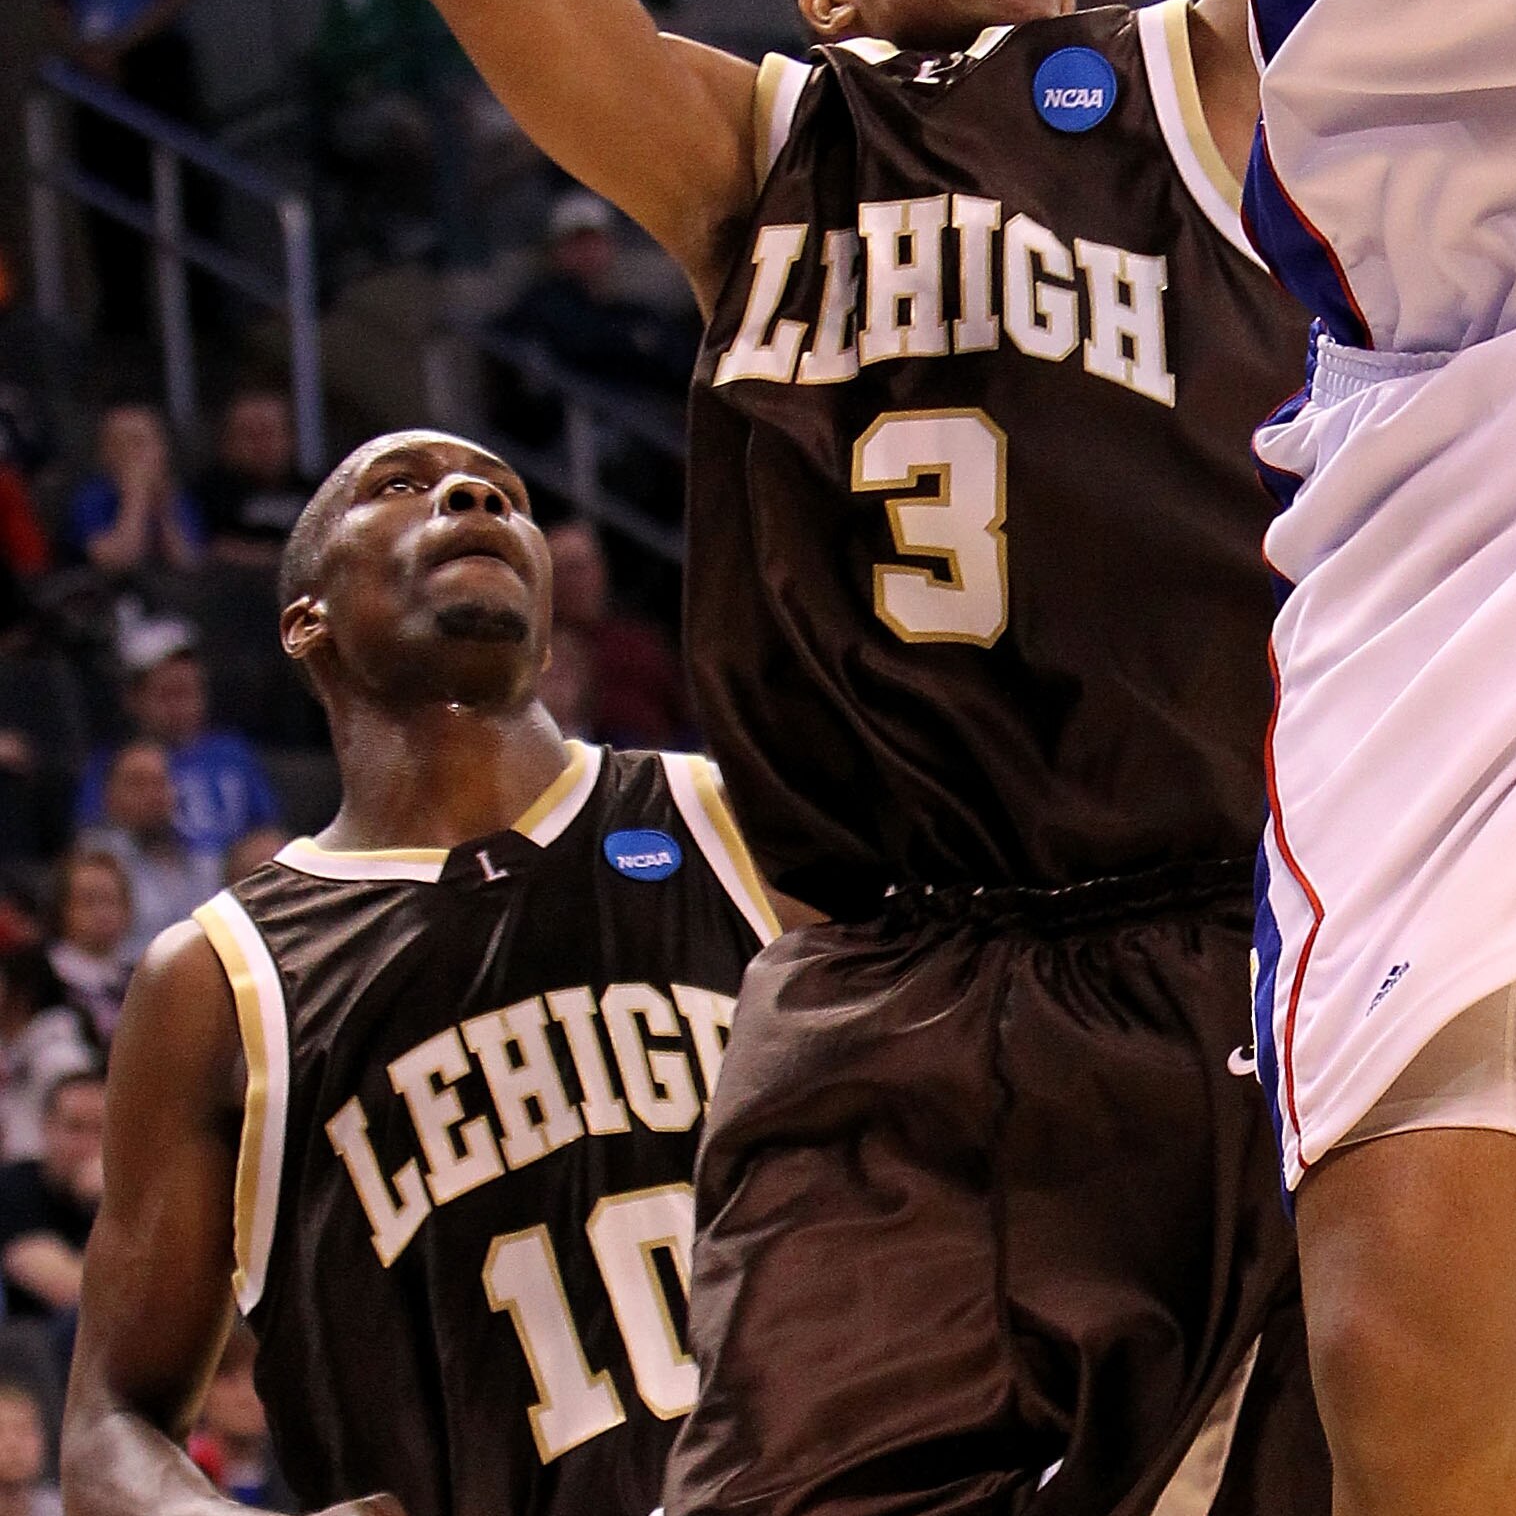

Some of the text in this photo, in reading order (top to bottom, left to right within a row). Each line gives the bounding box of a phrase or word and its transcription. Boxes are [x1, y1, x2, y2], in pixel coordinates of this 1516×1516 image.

[1043, 88, 1104, 109] NCAA
[712, 192, 1176, 408] LEHIGH
[851, 407, 1008, 648] 3
[475, 849, 510, 883] L
[616, 850, 673, 870] NCAA
[481, 1182, 701, 1466] 10
